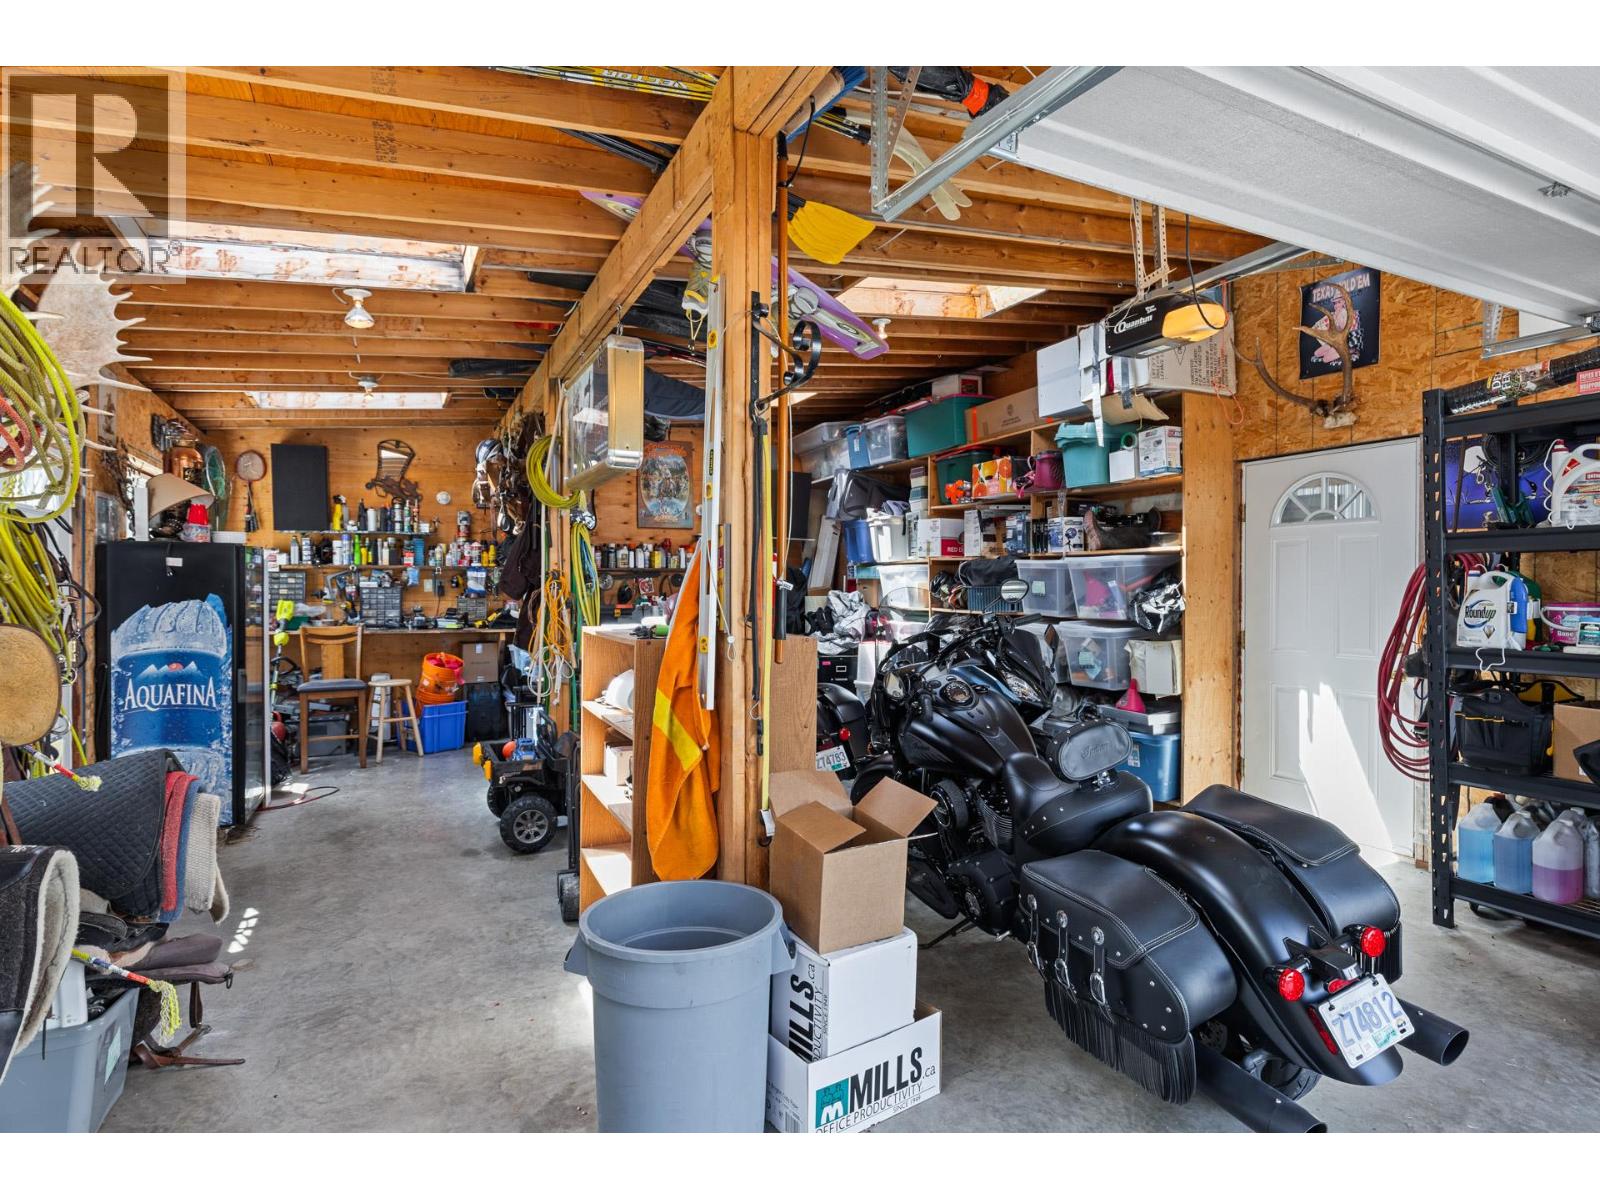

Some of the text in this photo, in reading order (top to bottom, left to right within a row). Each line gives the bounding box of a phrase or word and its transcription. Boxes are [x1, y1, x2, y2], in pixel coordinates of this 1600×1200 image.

[1114, 314, 1153, 334] Quantum
[1464, 605, 1497, 622] Roundup
[123, 676, 217, 711] AQUAFINA
[1332, 991, 1403, 1048] Z74812
[853, 1081, 923, 1121] PRODUCTIVITY
